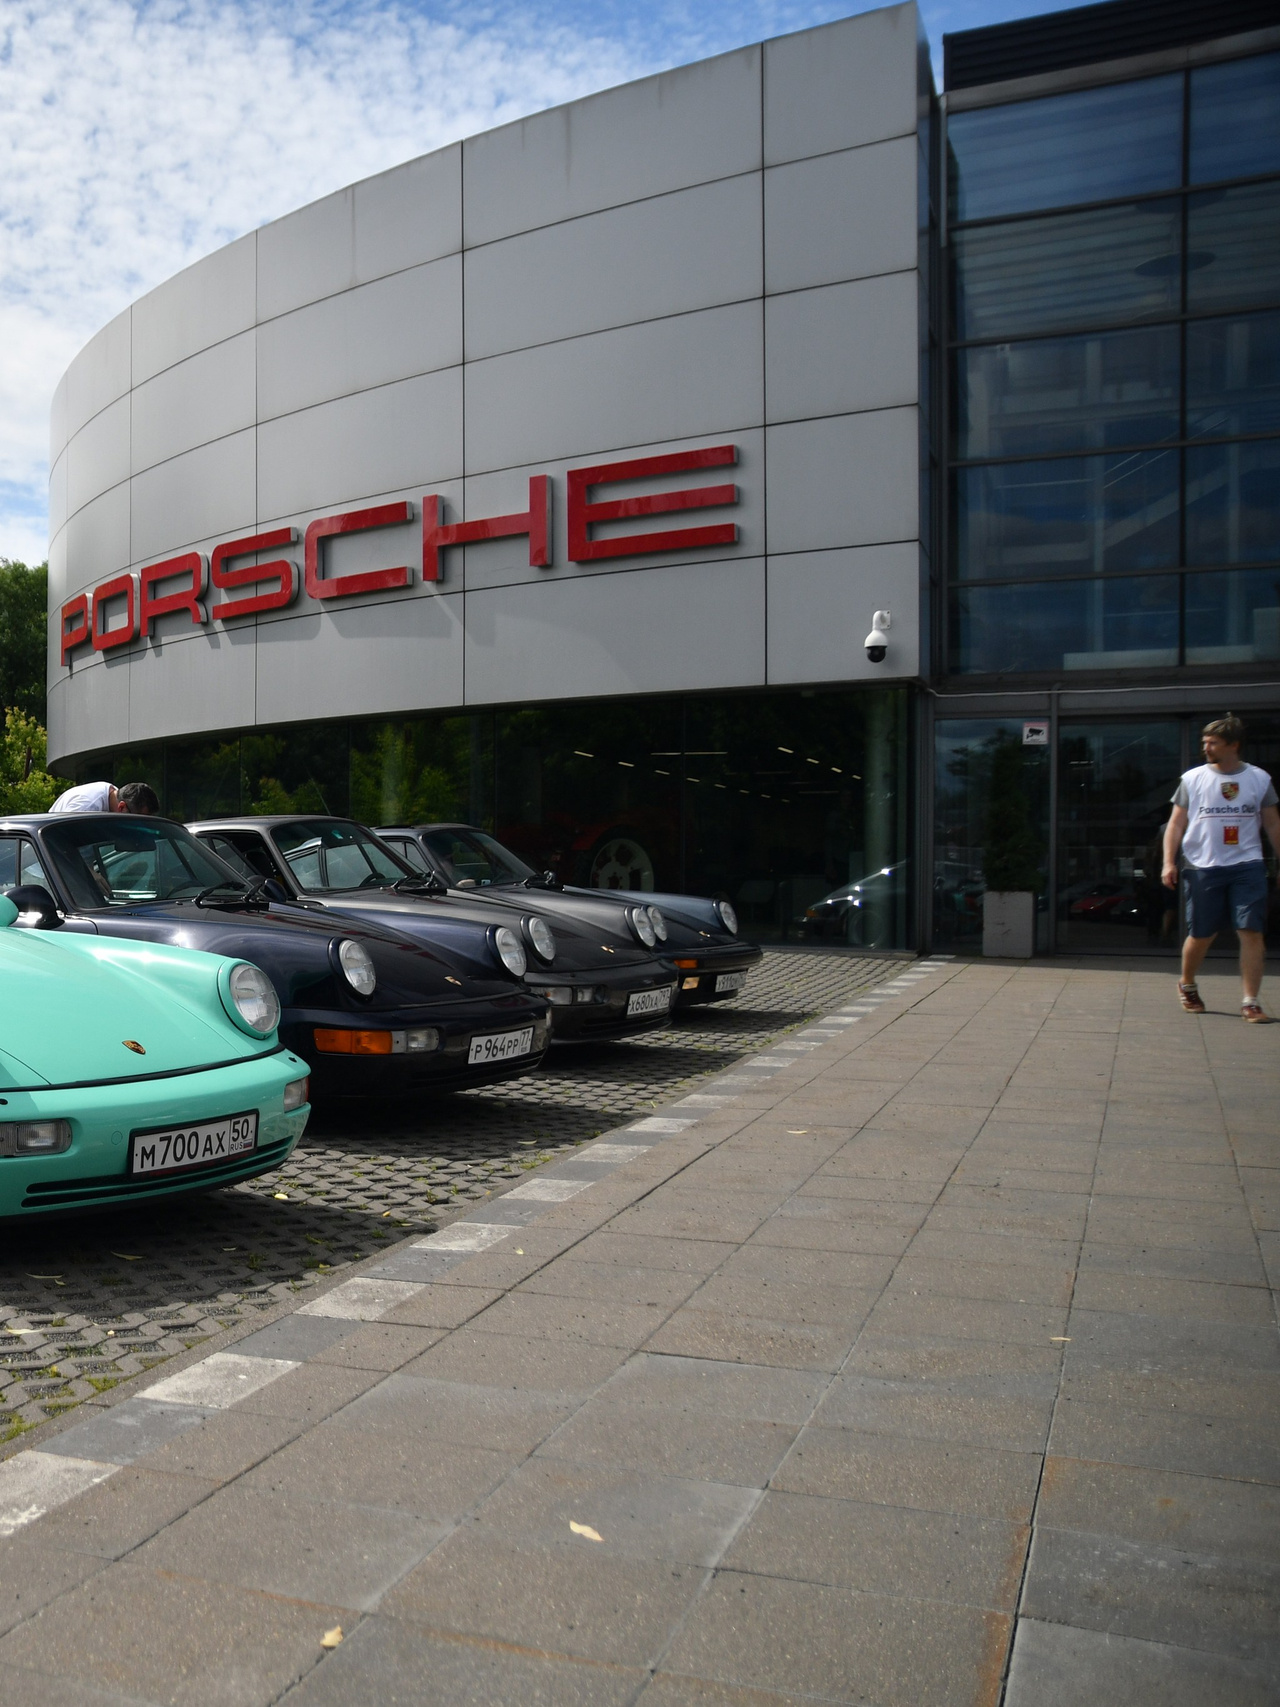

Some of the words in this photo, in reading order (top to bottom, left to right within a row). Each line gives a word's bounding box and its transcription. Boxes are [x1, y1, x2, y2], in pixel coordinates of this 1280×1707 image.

[61, 444, 739, 667] PORSCHE
[1199, 805, 1239, 814] Porsche
[140, 1131, 226, 1168] M700AX
[231, 1118, 249, 1142] 50
[230, 1141, 243, 1151] RUS
